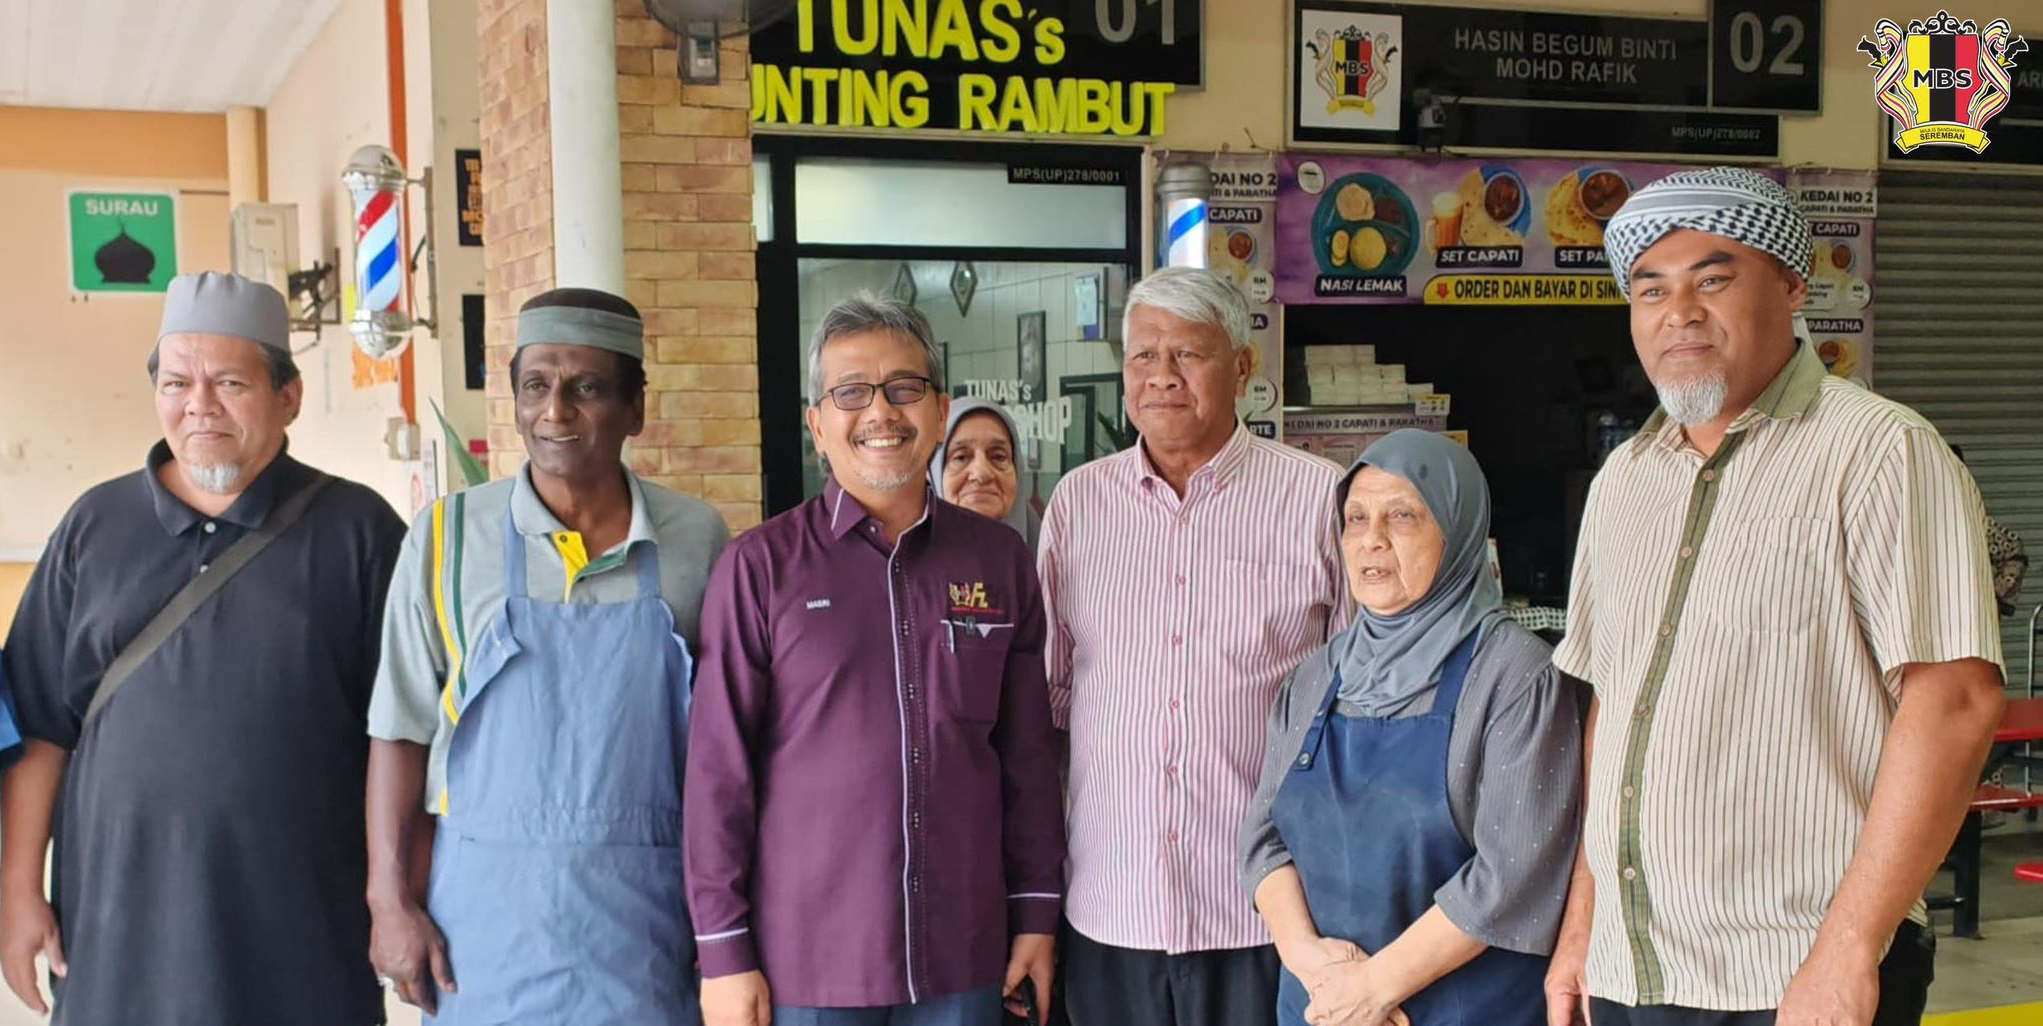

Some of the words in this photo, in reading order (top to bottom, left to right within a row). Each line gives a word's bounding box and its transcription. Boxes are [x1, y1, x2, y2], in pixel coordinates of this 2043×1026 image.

[1094, 0, 1174, 44] 01
[1455, 29, 1524, 52] HASIN
[1533, 32, 1612, 56] BEGUM
[1621, 38, 1677, 60] BINTI
[1730, 12, 1804, 75] 02
[1336, 60, 1369, 74] MBS
[1496, 58, 1563, 80] MOHD
[1571, 61, 1637, 83] RAFIK
[959, 73, 1175, 136] RAMBUT
[1013, 167, 1120, 182] MPS(UP)278/0001
[1240, 173, 1263, 186] NO
[1267, 173, 1277, 186] 2
[1800, 190, 1840, 203] KEDAI
[1843, 191, 1863, 203] NO
[1865, 192, 1874, 203] 2
[85, 199, 159, 216] SURAU
[1209, 208, 1258, 221] CAPATI
[1815, 223, 1858, 235] CAPATI
[1441, 249, 1464, 263] SET
[1467, 249, 1520, 263] CAPATI
[1559, 250, 1584, 263] SET
[1320, 278, 1354, 291] NASI
[1356, 279, 1405, 293] LEMAK
[1454, 279, 1499, 299] ORDER
[1503, 280, 1532, 299] DAN
[1534, 279, 1577, 299] BAYAR
[1580, 279, 1594, 299] DI
[1808, 320, 1861, 331] PARATHA
[964, 379, 1032, 401] TUNAS's
[1341, 419, 1377, 430] CAPATI
